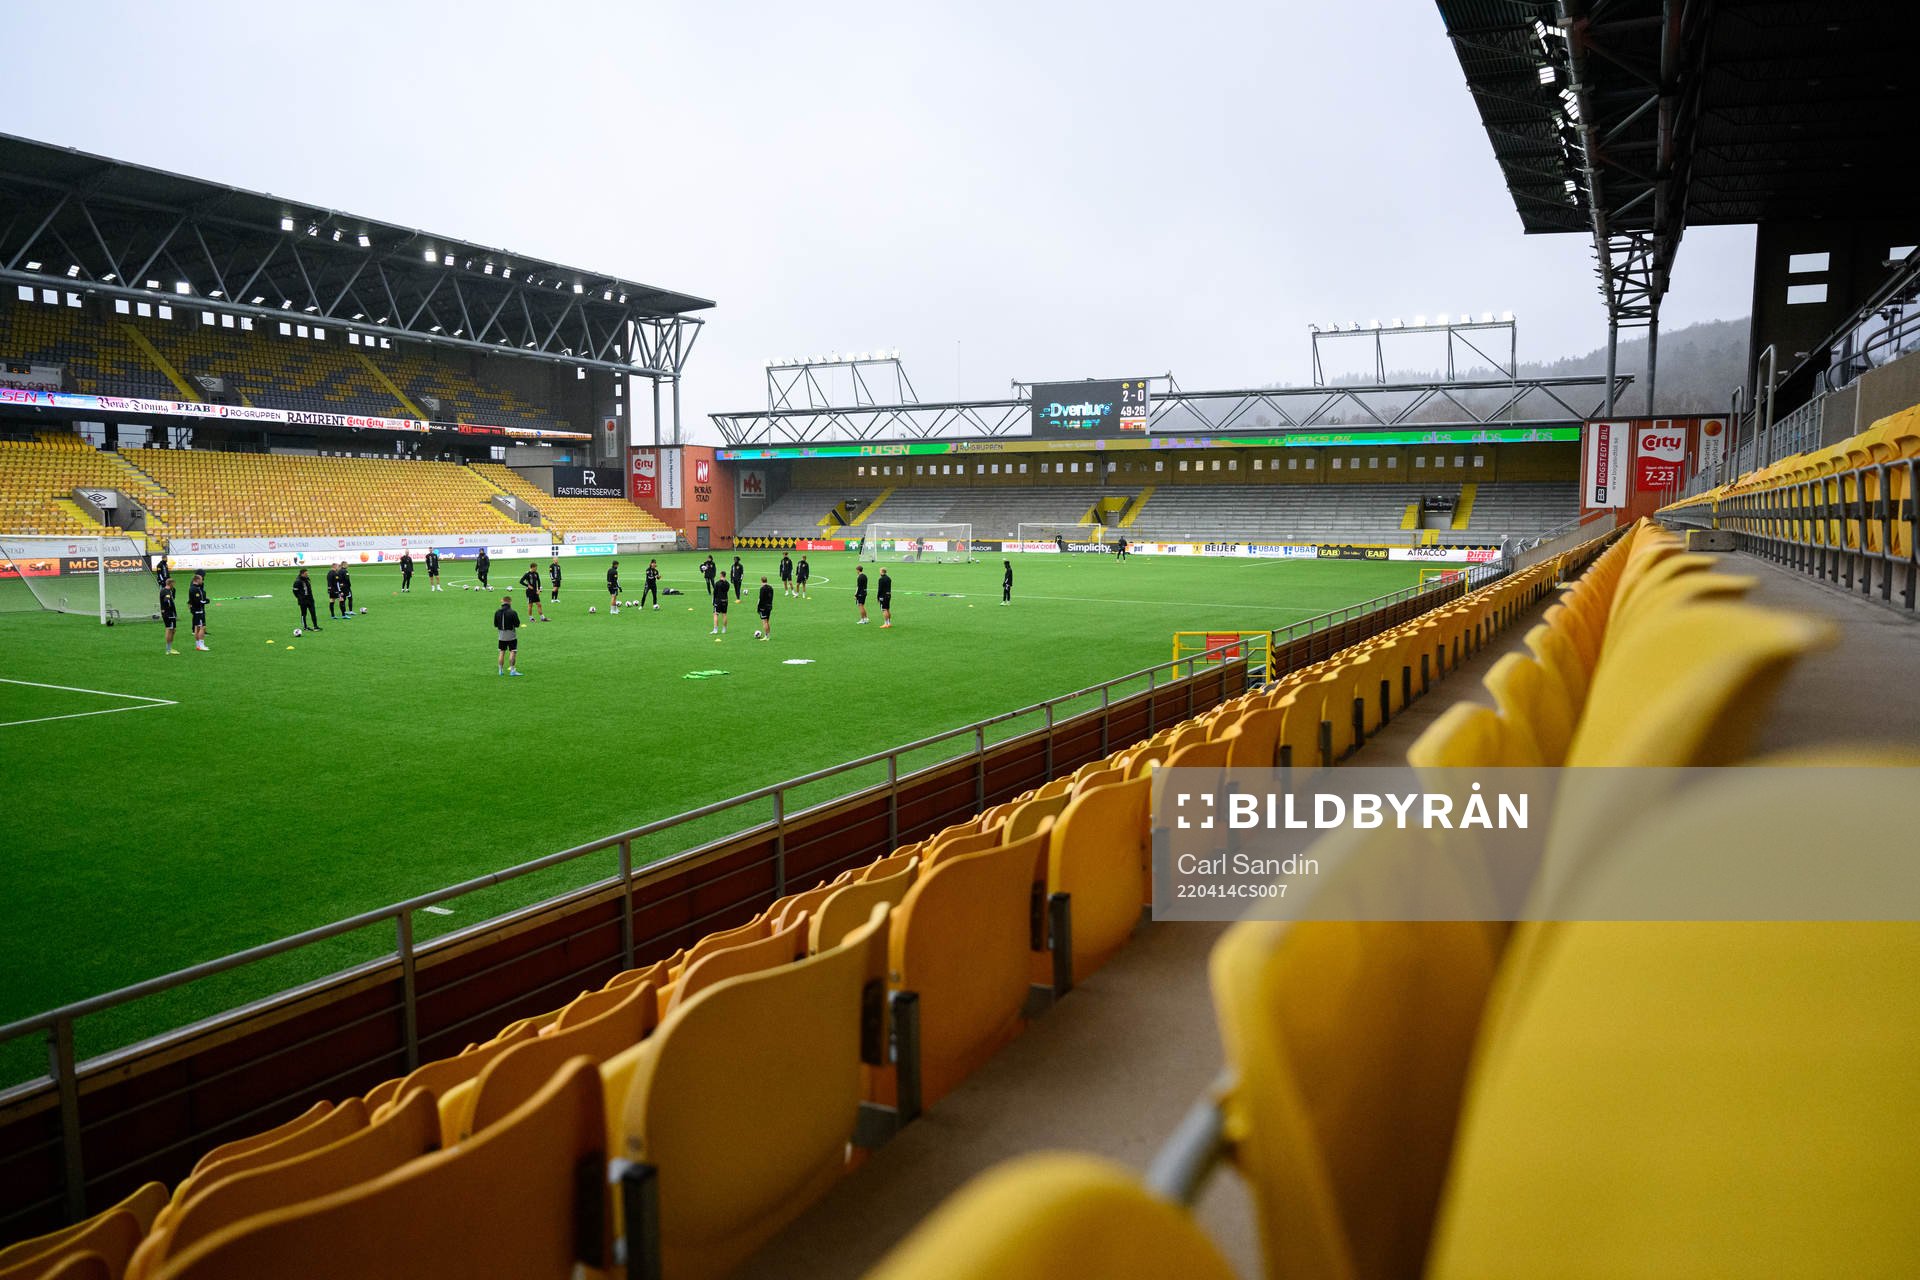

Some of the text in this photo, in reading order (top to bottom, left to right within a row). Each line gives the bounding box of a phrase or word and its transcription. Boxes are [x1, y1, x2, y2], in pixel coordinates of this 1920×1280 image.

[1122, 390, 1129, 402] 2
[1137, 390, 1144, 402] 0
[97, 397, 130, 408] Borås
[130, 400, 169, 413] Tidning
[176, 402, 211, 412] PEAB
[230, 409, 281, 420] RO-GRUPPEN
[287, 412, 346, 426] RAMIRENT
[346, 416, 365, 427] City
[366, 417, 385, 428] City
[1641, 434, 1682, 452] City
[634, 458, 654, 470] City
[1598, 440, 1607, 484] BOGSTEDT
[1645, 471, 1675, 482] 7-23
[557, 486, 622, 497] FASTIGHETSSERVICE
[637, 483, 652, 491] 7-23
[695, 494, 710, 503] STAD
[907, 541, 935, 551] Stna.
[1067, 543, 1112, 554] Simplicity.
[1204, 544, 1237, 552] BEIJER
[1320, 549, 1340, 557] EAB
[1366, 550, 1387, 558] EAB
[1407, 549, 1447, 557] ATRACCO
[235, 554, 255, 568] aki
